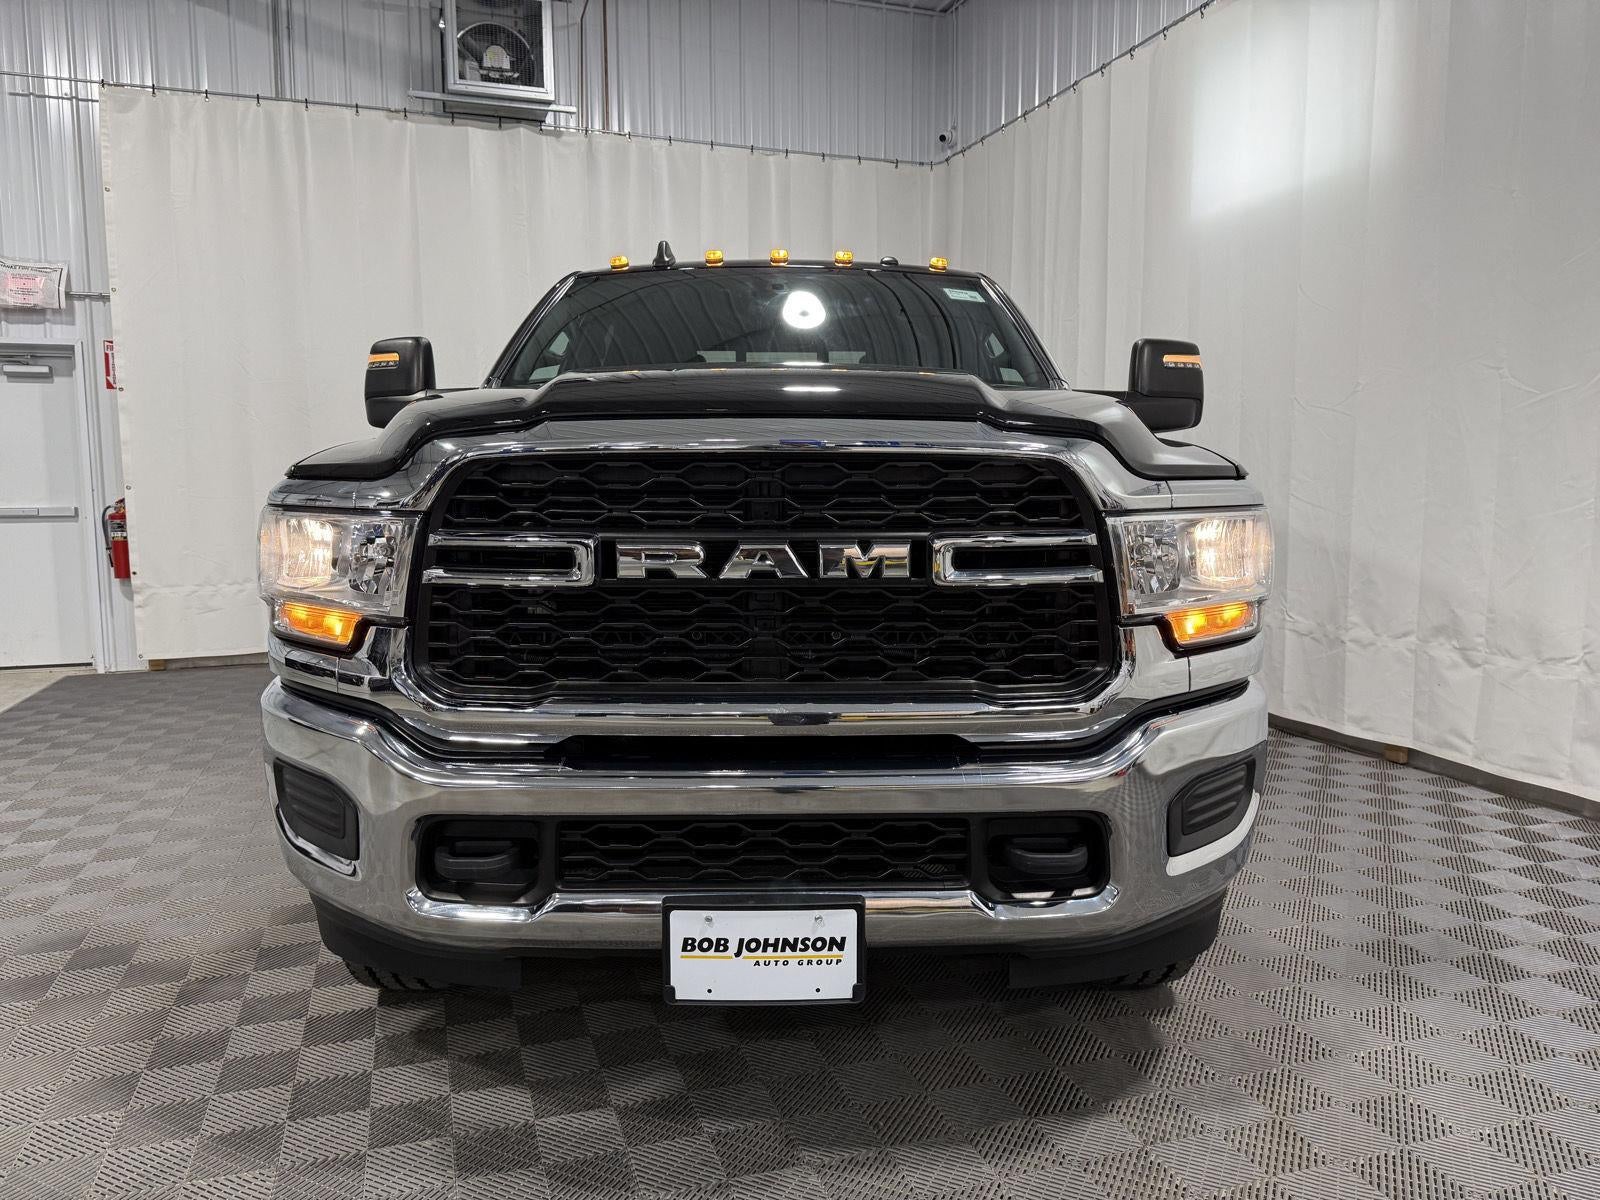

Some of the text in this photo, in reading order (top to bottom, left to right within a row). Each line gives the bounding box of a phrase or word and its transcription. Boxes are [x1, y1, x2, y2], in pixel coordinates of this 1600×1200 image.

[616, 540, 911, 579] RAM
[681, 936, 847, 958] BOB JOHNSON
